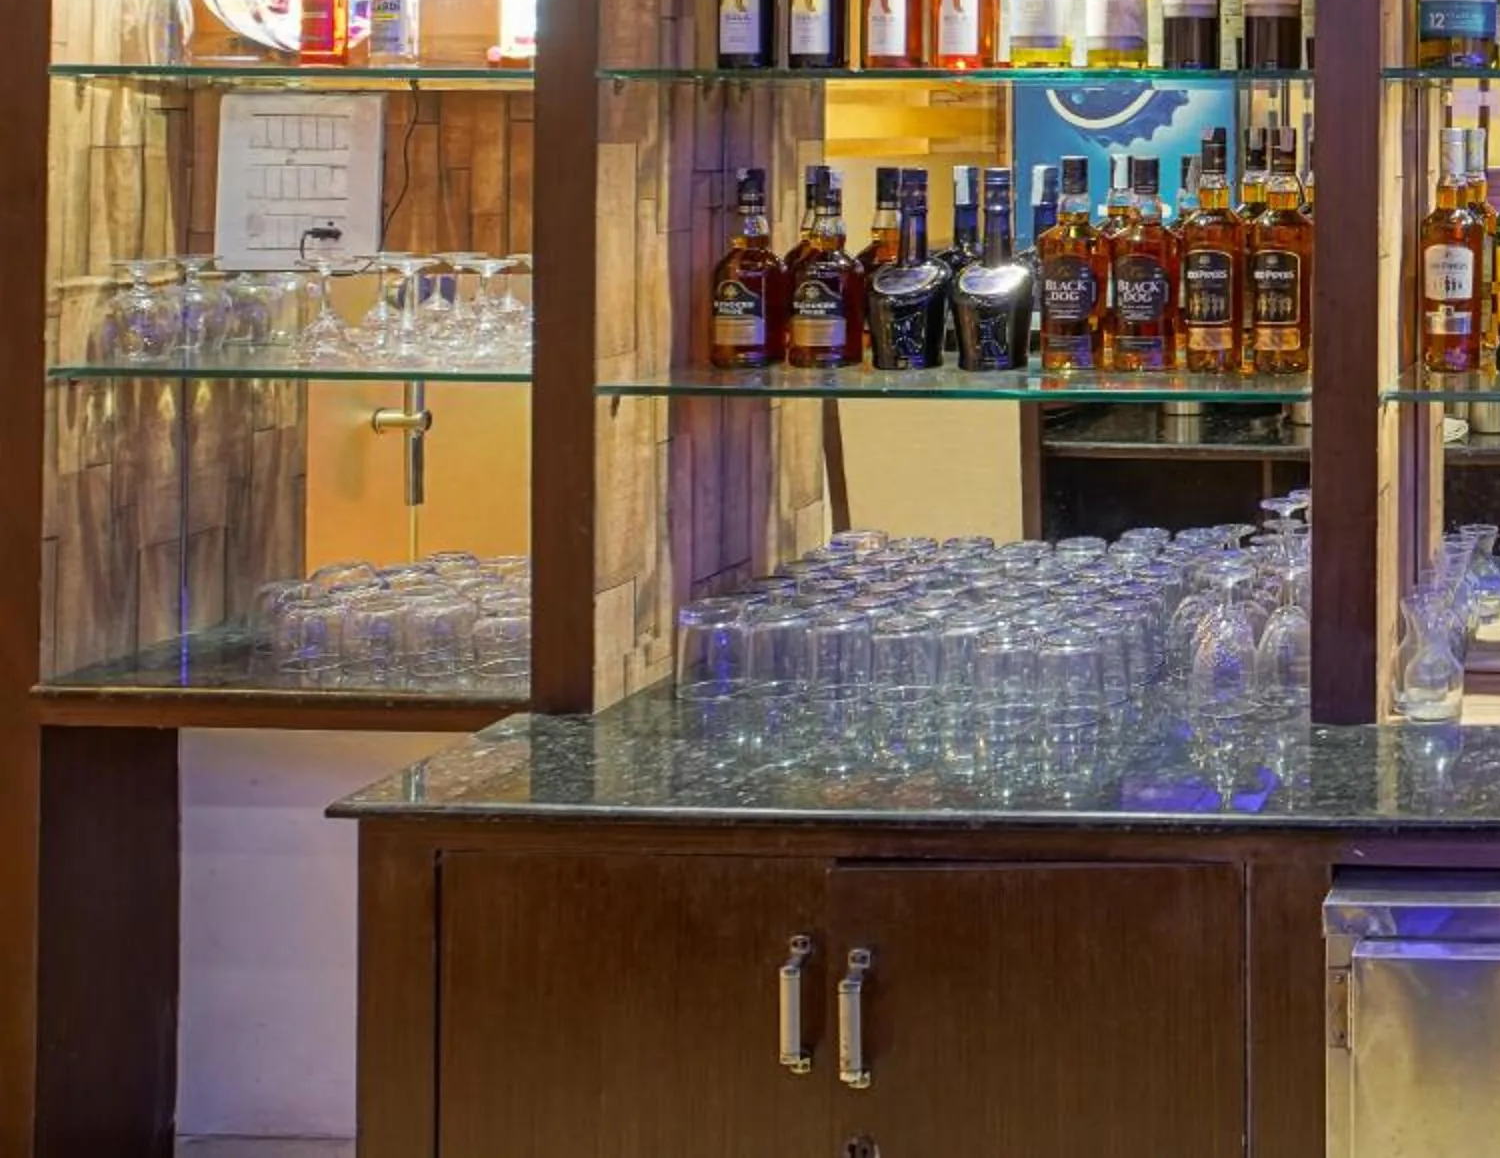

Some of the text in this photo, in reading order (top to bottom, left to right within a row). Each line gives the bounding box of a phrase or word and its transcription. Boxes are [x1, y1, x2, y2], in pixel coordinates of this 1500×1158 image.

[1429, 12, 1445, 30] 12
[1045, 279, 1087, 291] BLACK
[1117, 279, 1160, 292] BLACK
[1051, 291, 1080, 301] DOG
[1123, 292, 1153, 303] DOG
